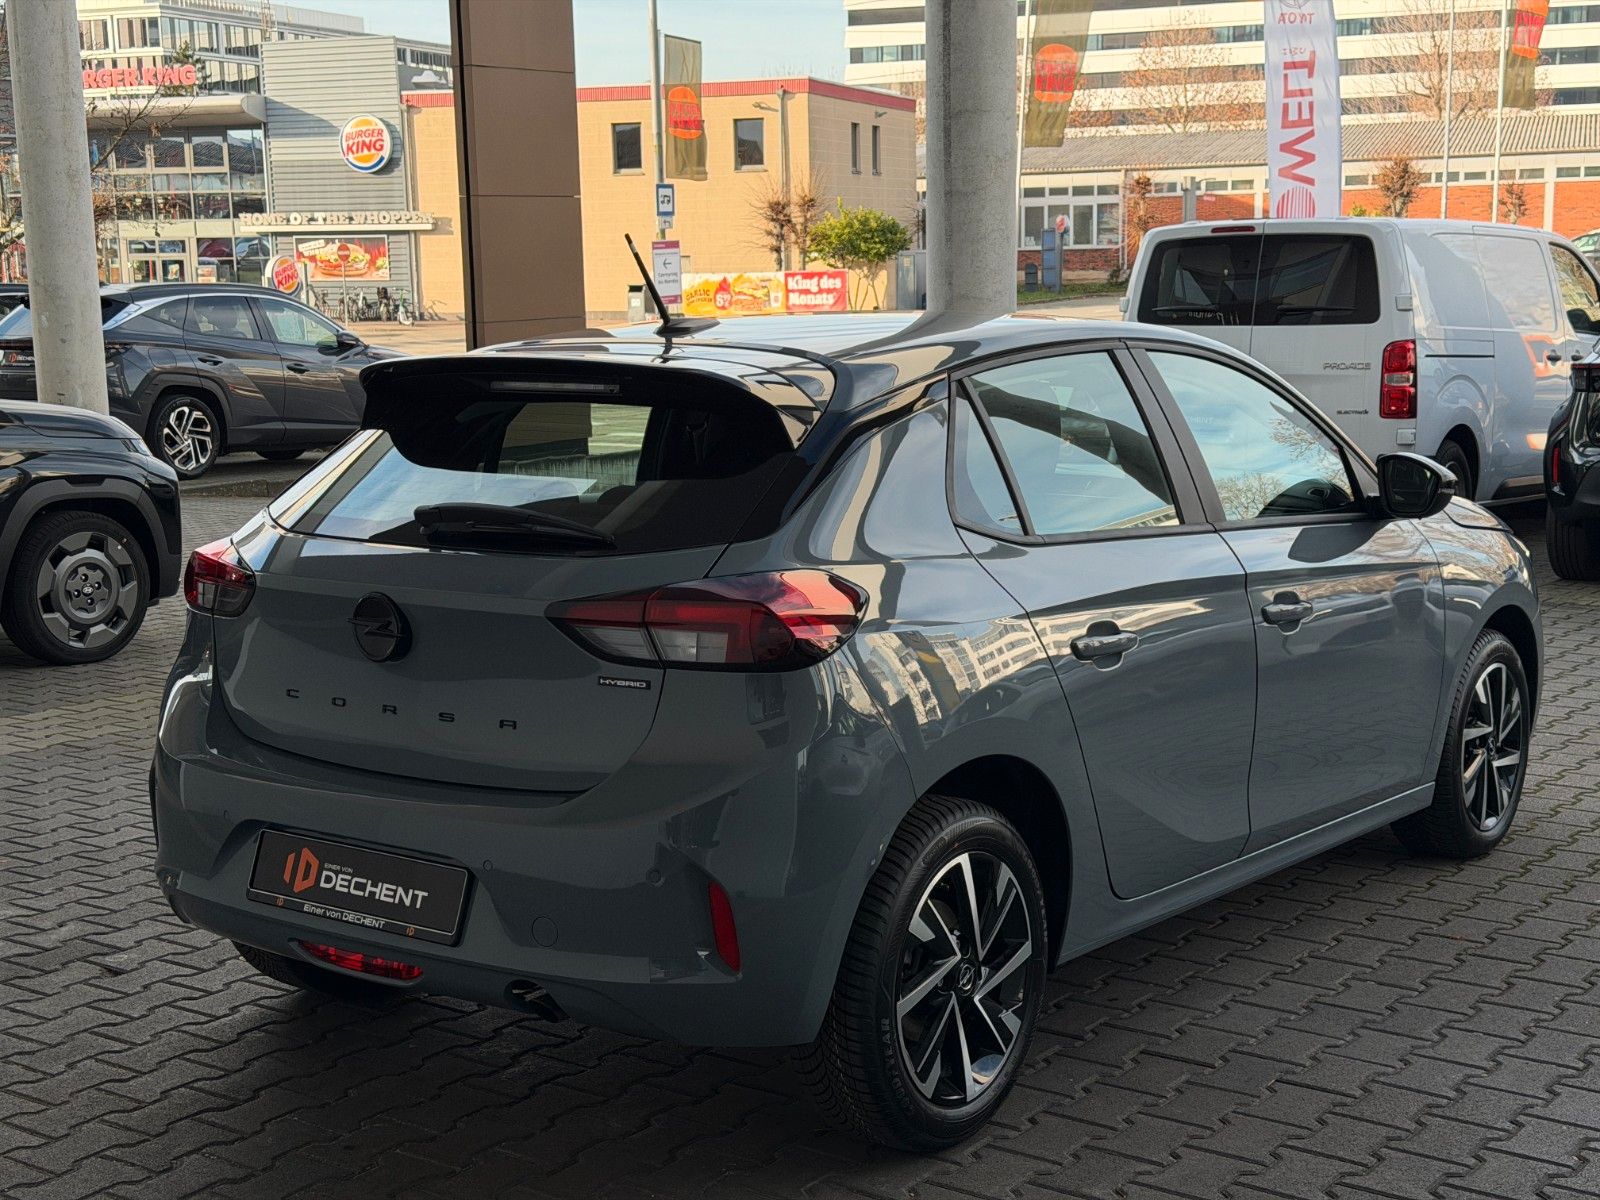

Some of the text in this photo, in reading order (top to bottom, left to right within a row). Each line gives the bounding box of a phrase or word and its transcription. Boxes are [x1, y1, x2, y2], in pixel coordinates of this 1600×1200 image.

[142, 65, 196, 86] KING
[345, 128, 384, 142] BURGER
[346, 138, 385, 157] KING
[238, 210, 435, 226] HOME OF THE WHOPPER
[276, 270, 299, 289] KING
[786, 274, 842, 293] King des
[1323, 362, 1372, 370] PROACE
[599, 678, 648, 689] HYBRID
[286, 688, 518, 731] CORSA
[324, 862, 354, 873] EINER VON
[319, 870, 429, 909] DECHENT
[303, 904, 386, 929] Einer von DECHENT
